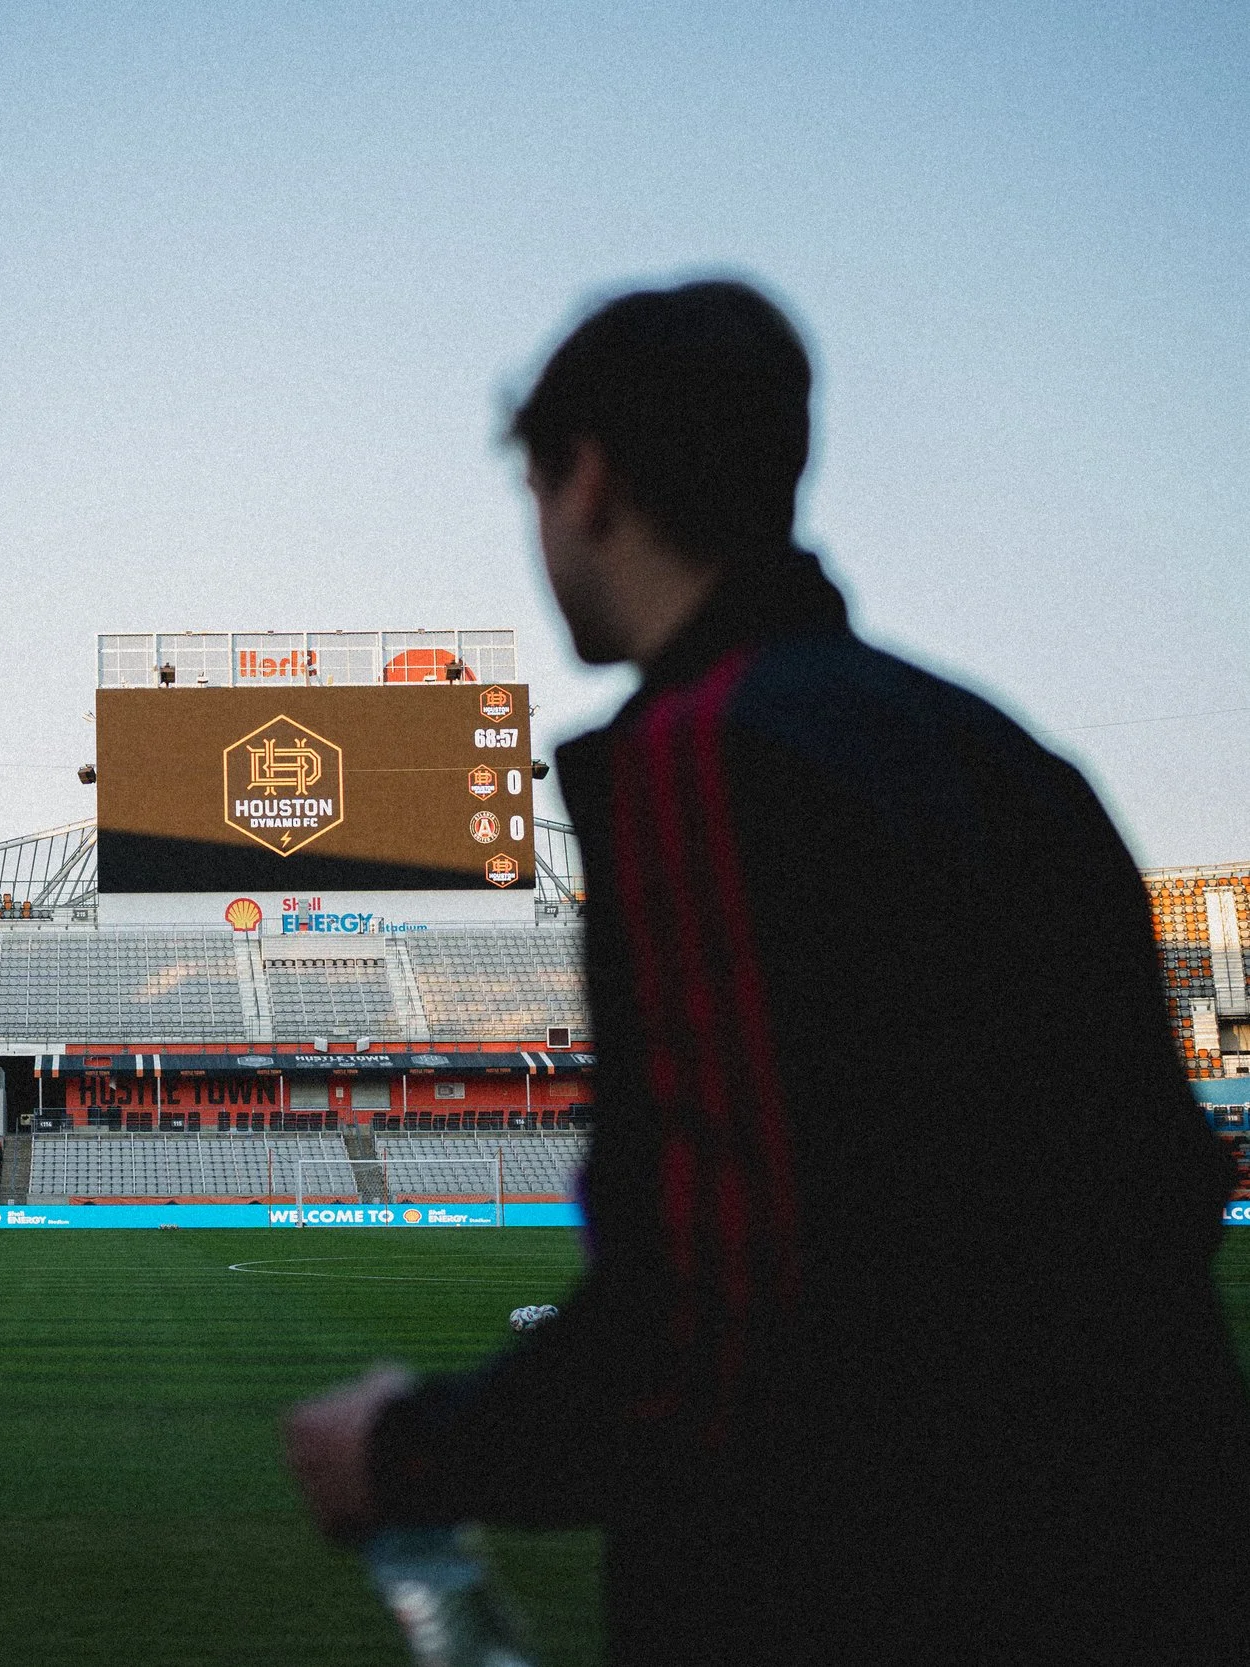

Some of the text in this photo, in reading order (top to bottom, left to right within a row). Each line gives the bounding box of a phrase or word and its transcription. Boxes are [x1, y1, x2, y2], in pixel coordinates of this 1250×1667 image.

[474, 728, 519, 748] 68:57
[507, 769, 522, 795] 0
[235, 799, 332, 817] HOUSTON
[250, 818, 318, 828] DYNAMO FC
[510, 815, 524, 841] 0
[193, 1074, 276, 1105] TOWN
[7, 1216, 47, 1225] ENERGY
[269, 1209, 395, 1223] WELCOME TO
[428, 1214, 468, 1223] ENERGY
